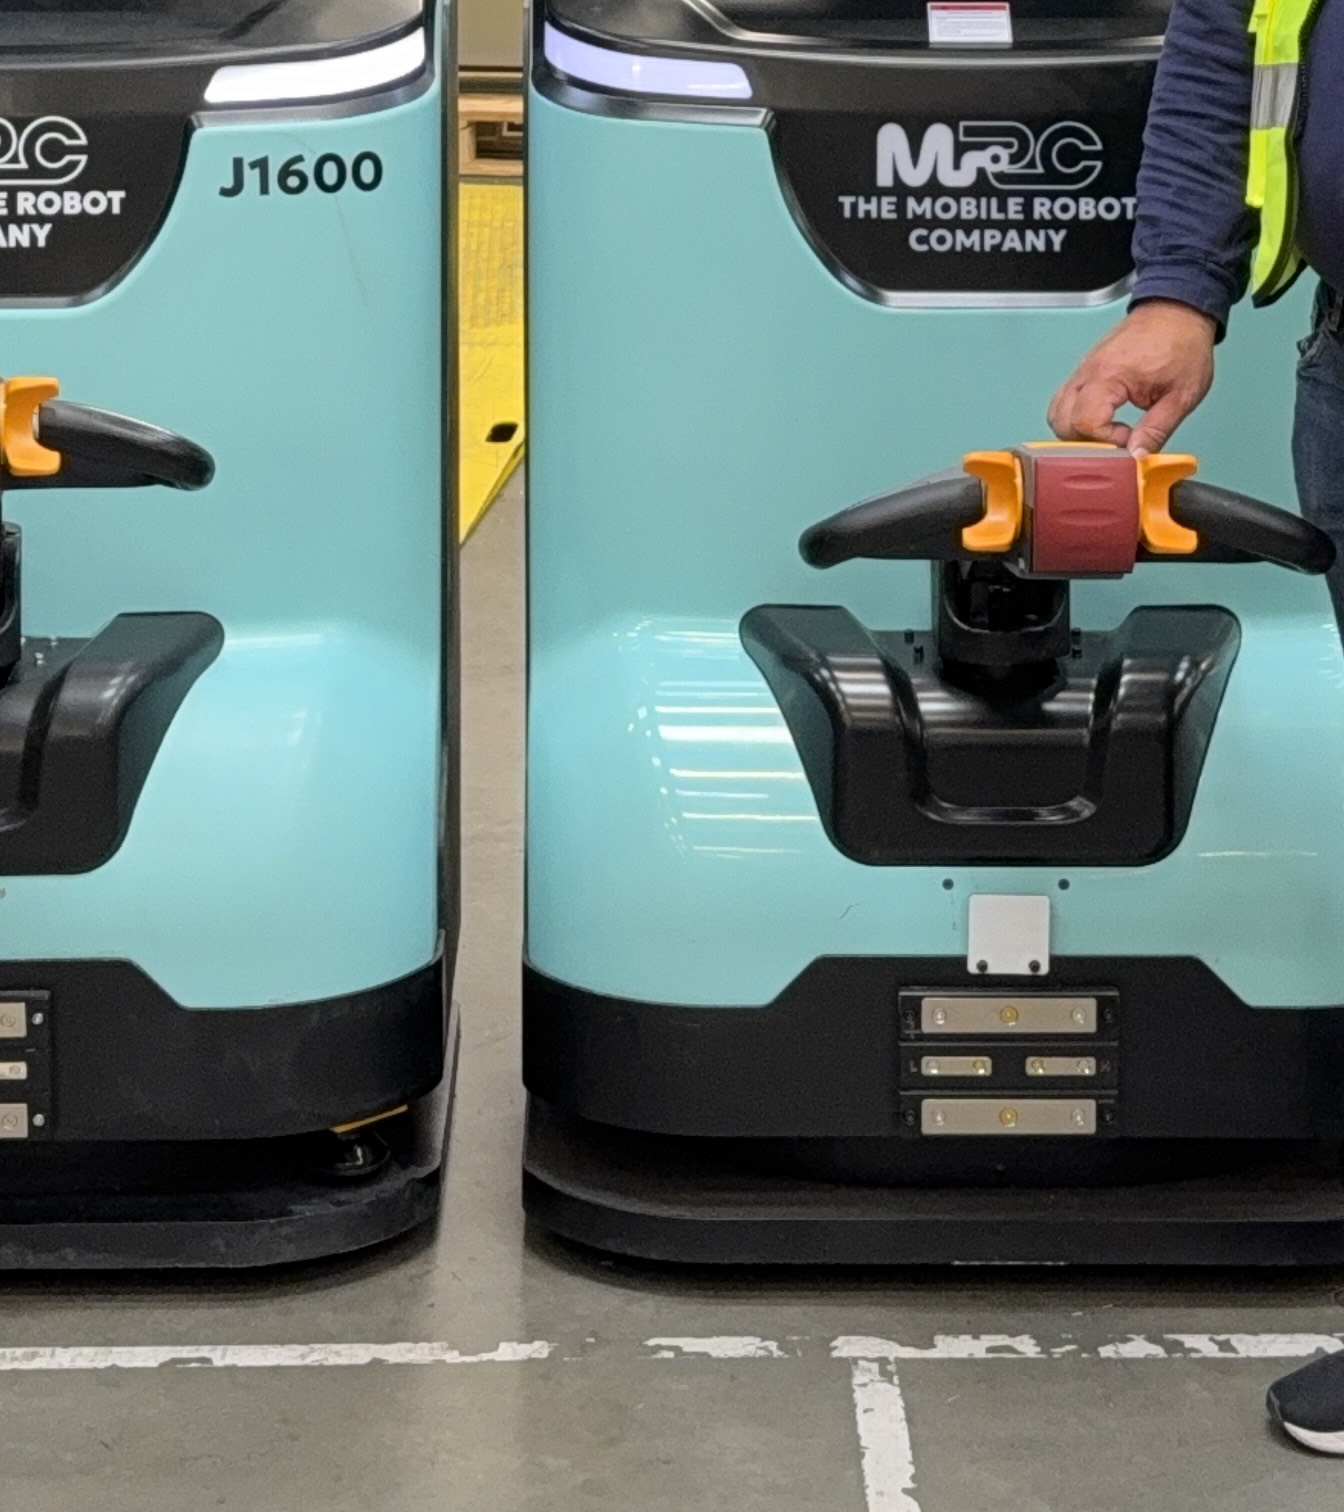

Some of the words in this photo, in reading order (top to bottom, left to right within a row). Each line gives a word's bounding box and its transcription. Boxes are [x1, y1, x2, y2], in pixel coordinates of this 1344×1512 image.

[218, 150, 384, 198] J1600
[17, 190, 126, 216] ROBOT
[838, 195, 898, 220] THE
[906, 195, 1025, 220] MOBILE
[1032, 195, 1137, 221] ROBOT
[908, 228, 1068, 253] COMPANY
